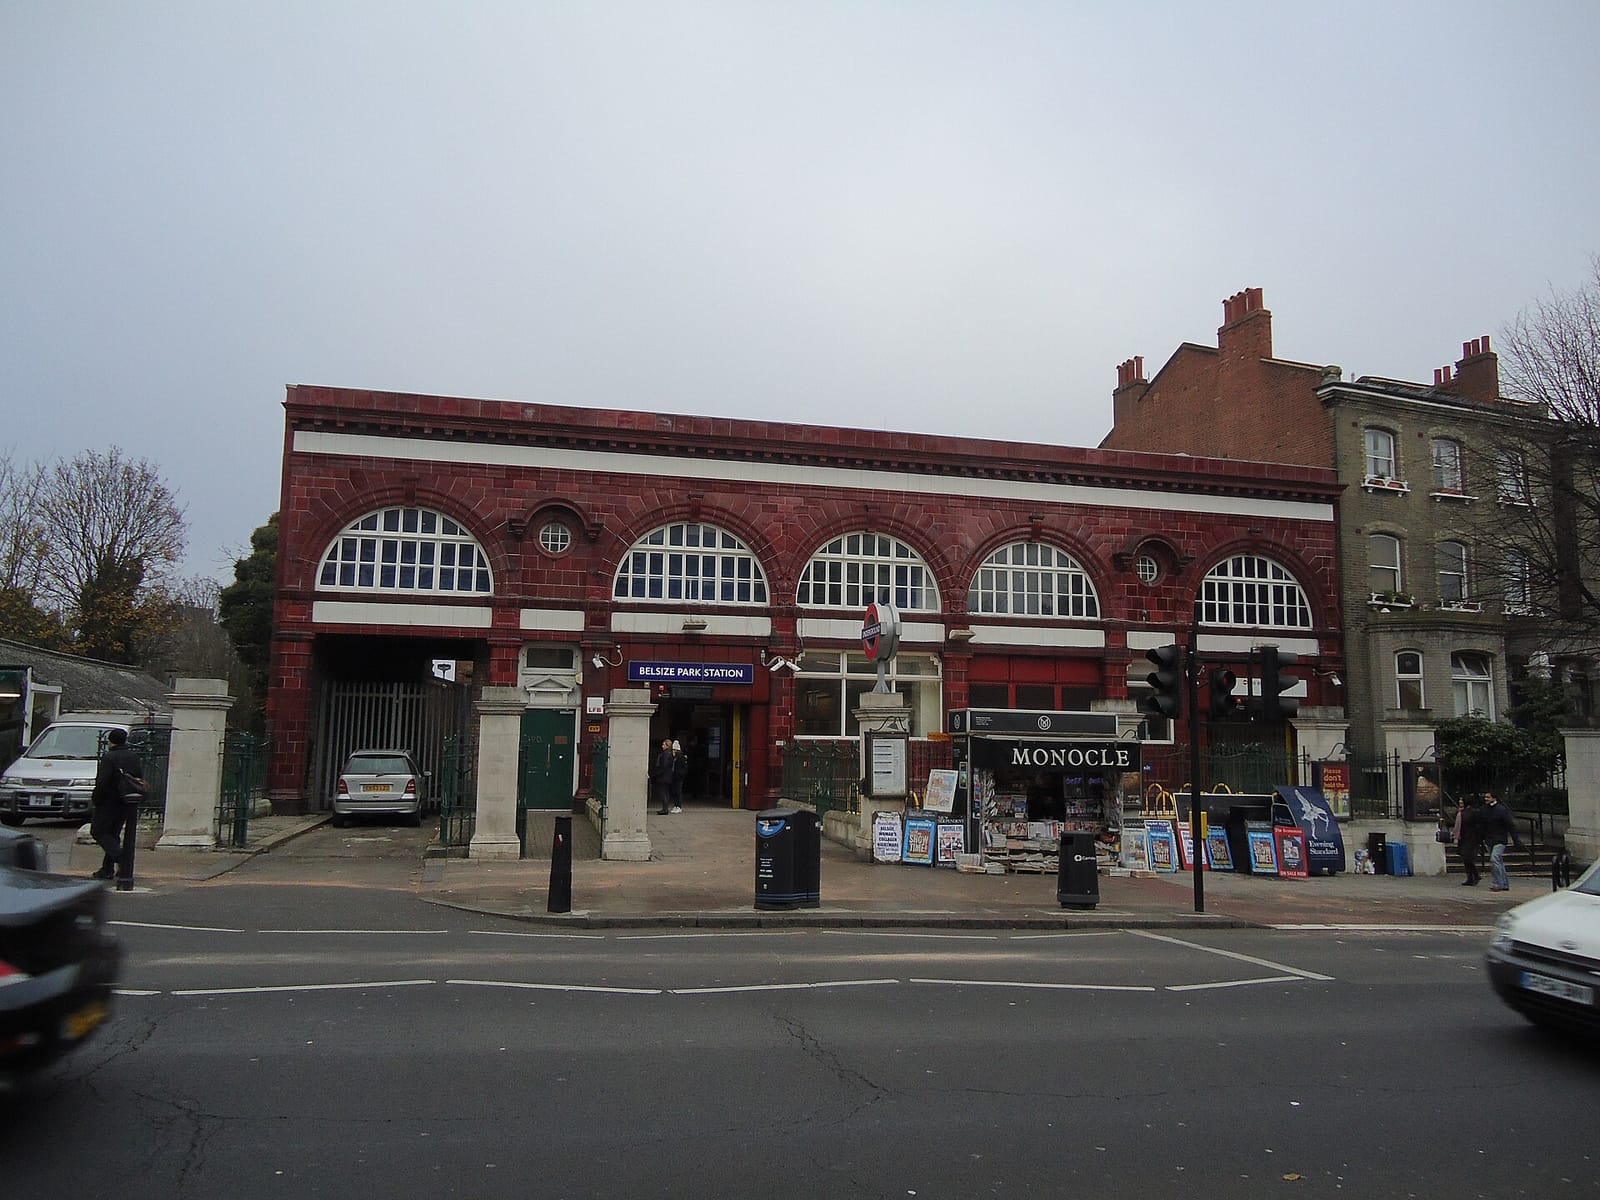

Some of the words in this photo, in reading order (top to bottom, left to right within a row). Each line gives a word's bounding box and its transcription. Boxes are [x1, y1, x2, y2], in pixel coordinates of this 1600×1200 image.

[639, 667, 675, 676] BELSIZE
[677, 668, 701, 677] PARK
[703, 669, 743, 678] STATION
[1011, 748, 1130, 767] MONOCLE
[910, 834, 928, 844] SHOW
[910, 843, 928, 853] TIME!
[1308, 840, 1335, 849] Evening
[1309, 848, 1339, 856] Standard
